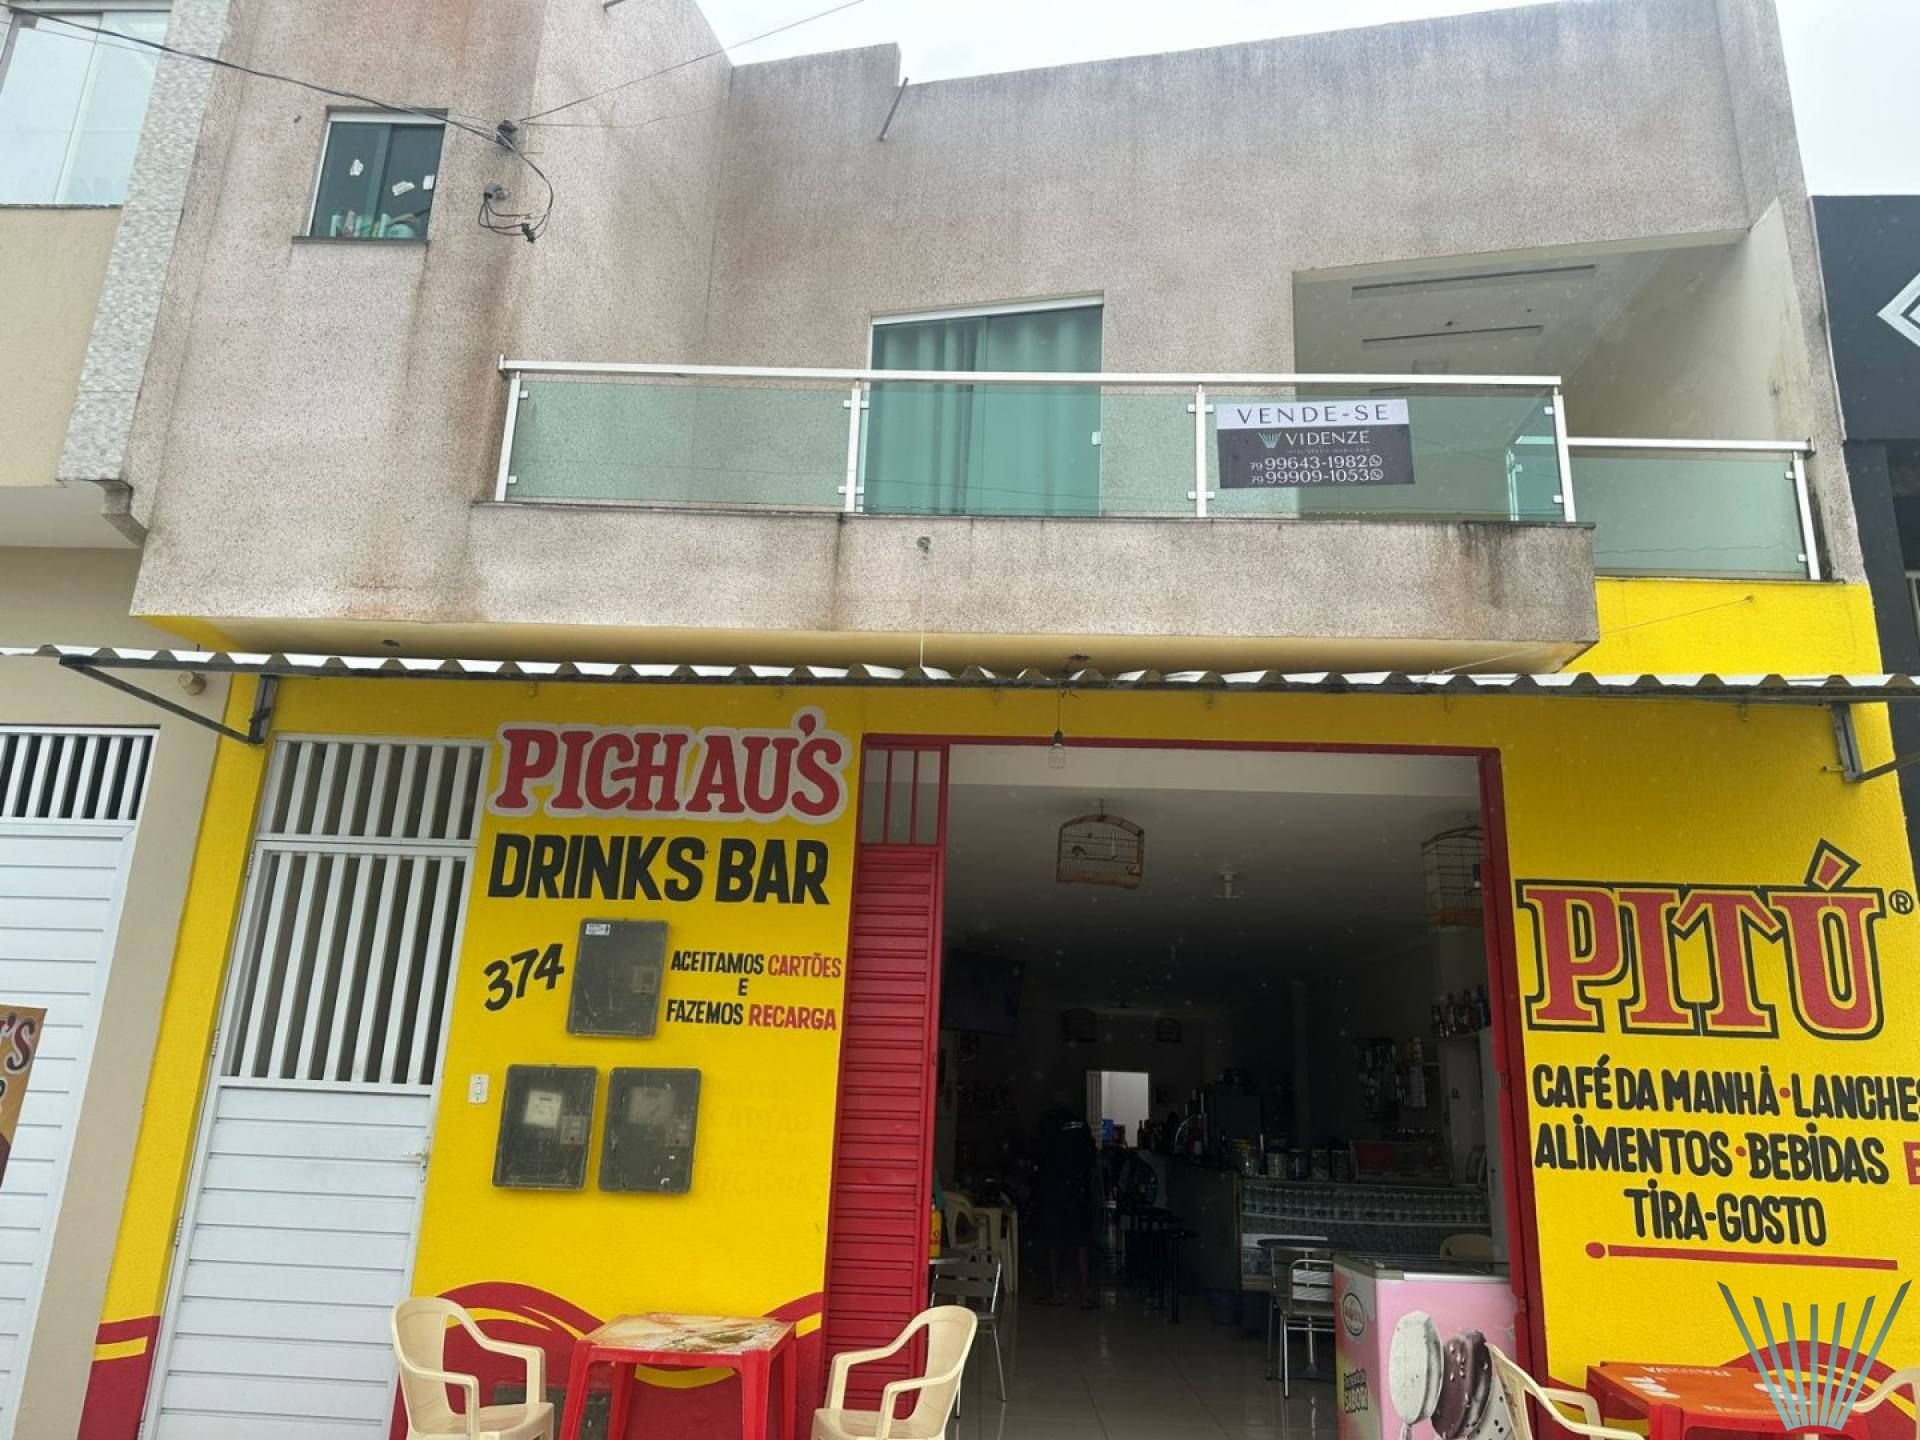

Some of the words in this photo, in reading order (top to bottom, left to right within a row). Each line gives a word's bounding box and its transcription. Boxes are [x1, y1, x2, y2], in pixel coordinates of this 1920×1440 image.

[1236, 403, 1389, 425] VENDE-SE
[1285, 430, 1371, 446] VIDENZE
[1264, 454, 1369, 470] 99643-1982
[1265, 468, 1370, 485] 99909-1053
[492, 711, 845, 818] PICHAU'S
[487, 833, 706, 902] DRINKS
[715, 838, 831, 905] BAR
[1515, 838, 1888, 1041] PITÚ
[483, 942, 565, 1013] 374
[671, 950, 765, 975] ACEITAMOS
[767, 951, 842, 979] CARTÕES
[737, 977, 749, 997] E
[666, 998, 744, 1026] FAZEMOS
[749, 1003, 838, 1032] RECARGA
[1532, 1053, 1613, 1111] CAFÉ
[1616, 1066, 1660, 1113] DA
[1534, 1114, 1734, 1178] ALIMENTOS
[1744, 1122, 1890, 1185] BEBIDAS
[1623, 1179, 1828, 1248] TIRA-GOSTO
